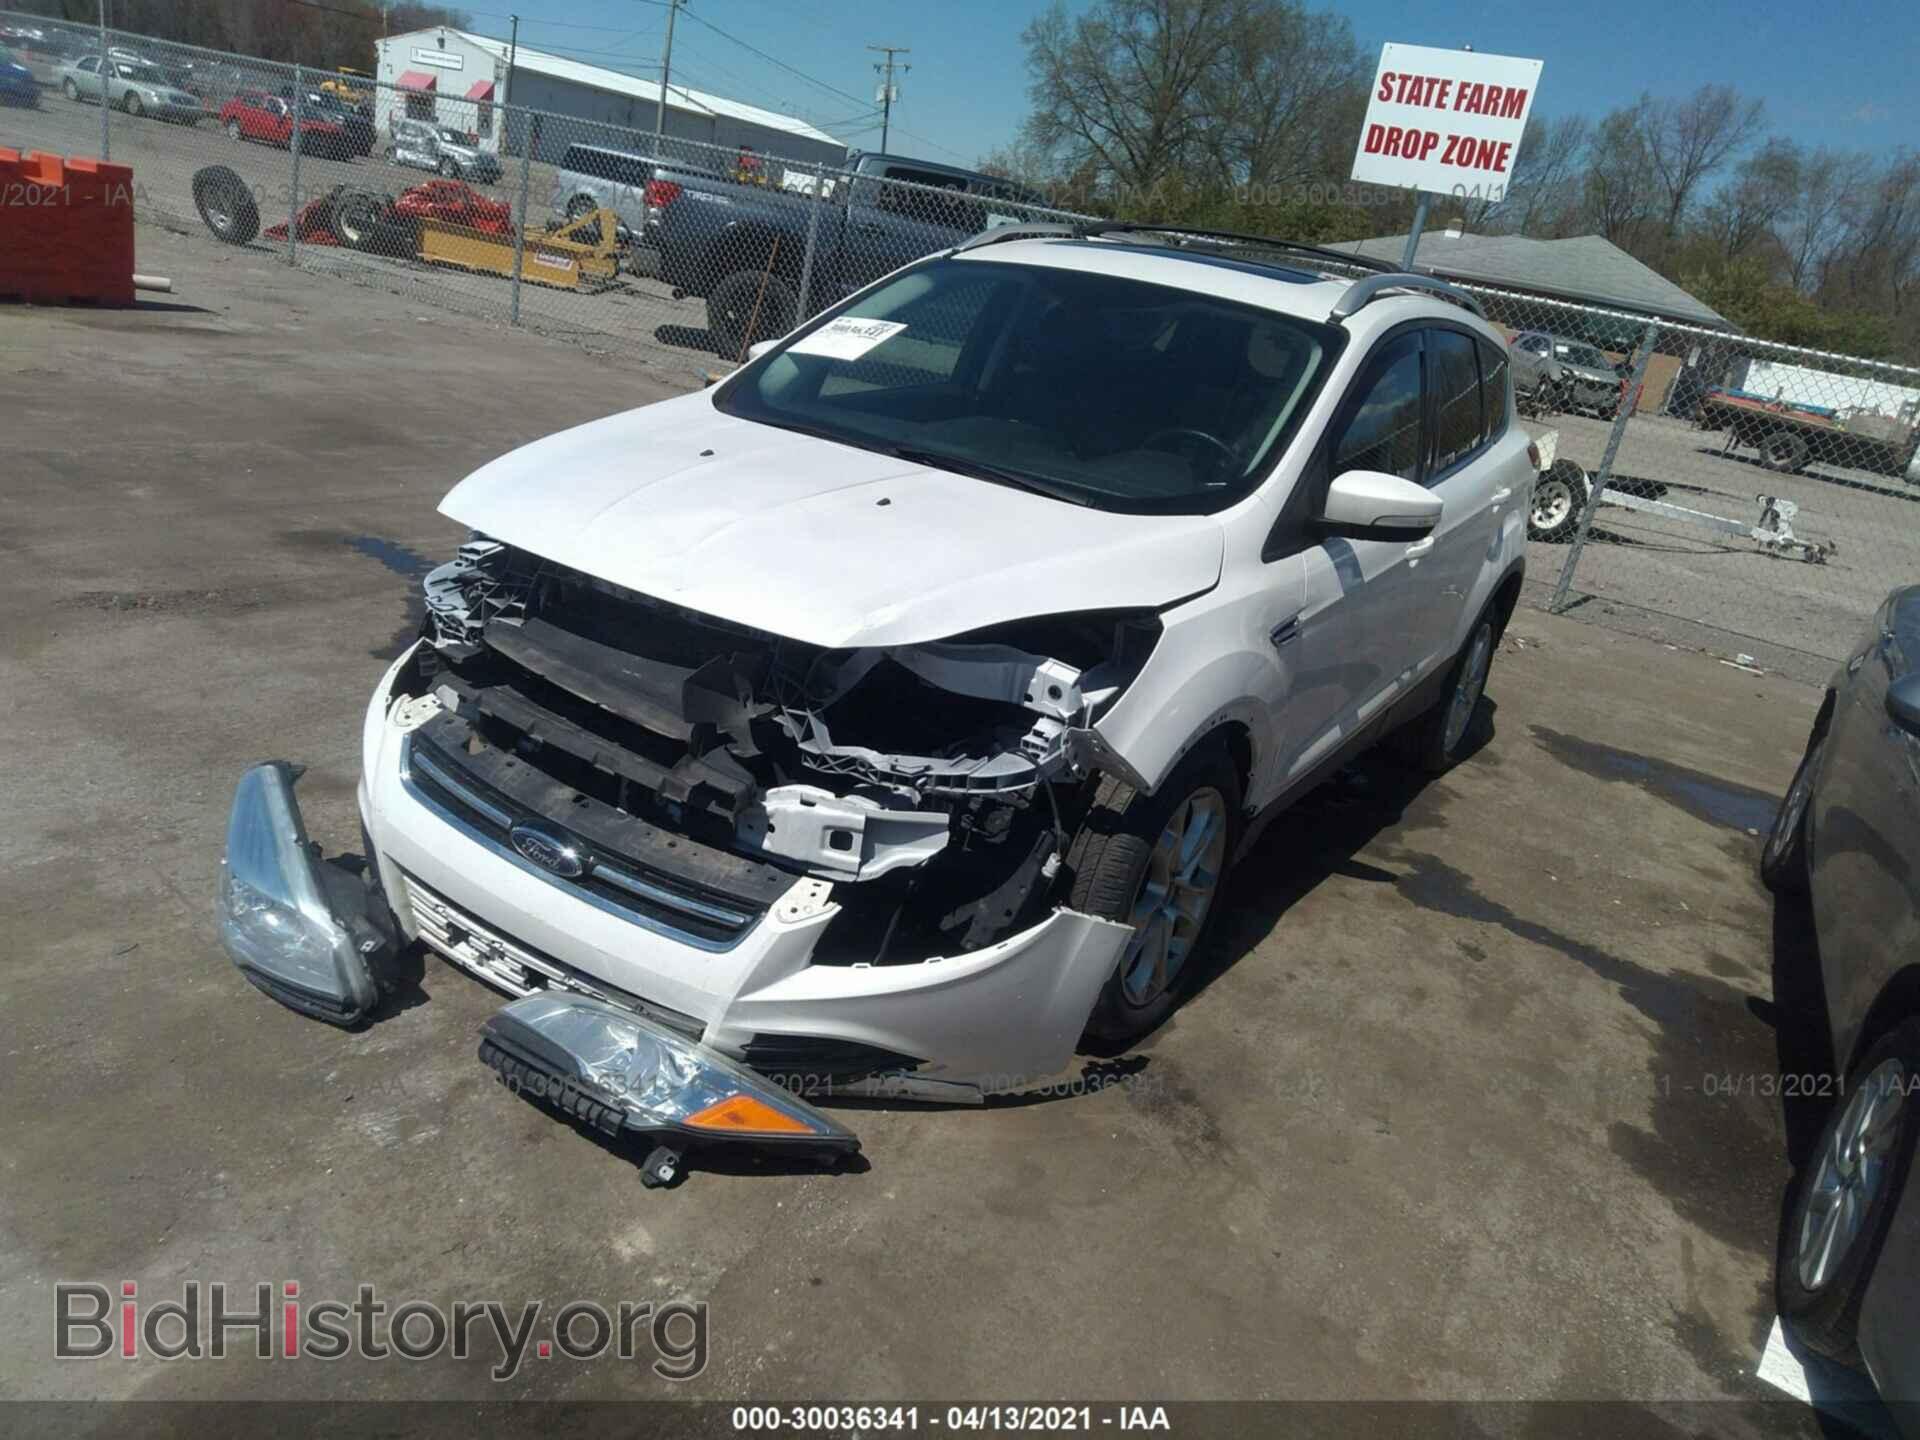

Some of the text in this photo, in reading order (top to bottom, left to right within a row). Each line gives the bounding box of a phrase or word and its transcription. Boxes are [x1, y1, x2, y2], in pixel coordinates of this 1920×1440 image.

[1377, 71, 1528, 120] STATE FARM
[1363, 123, 1512, 173] DROP ZONE
[524, 837, 563, 869] Ford
